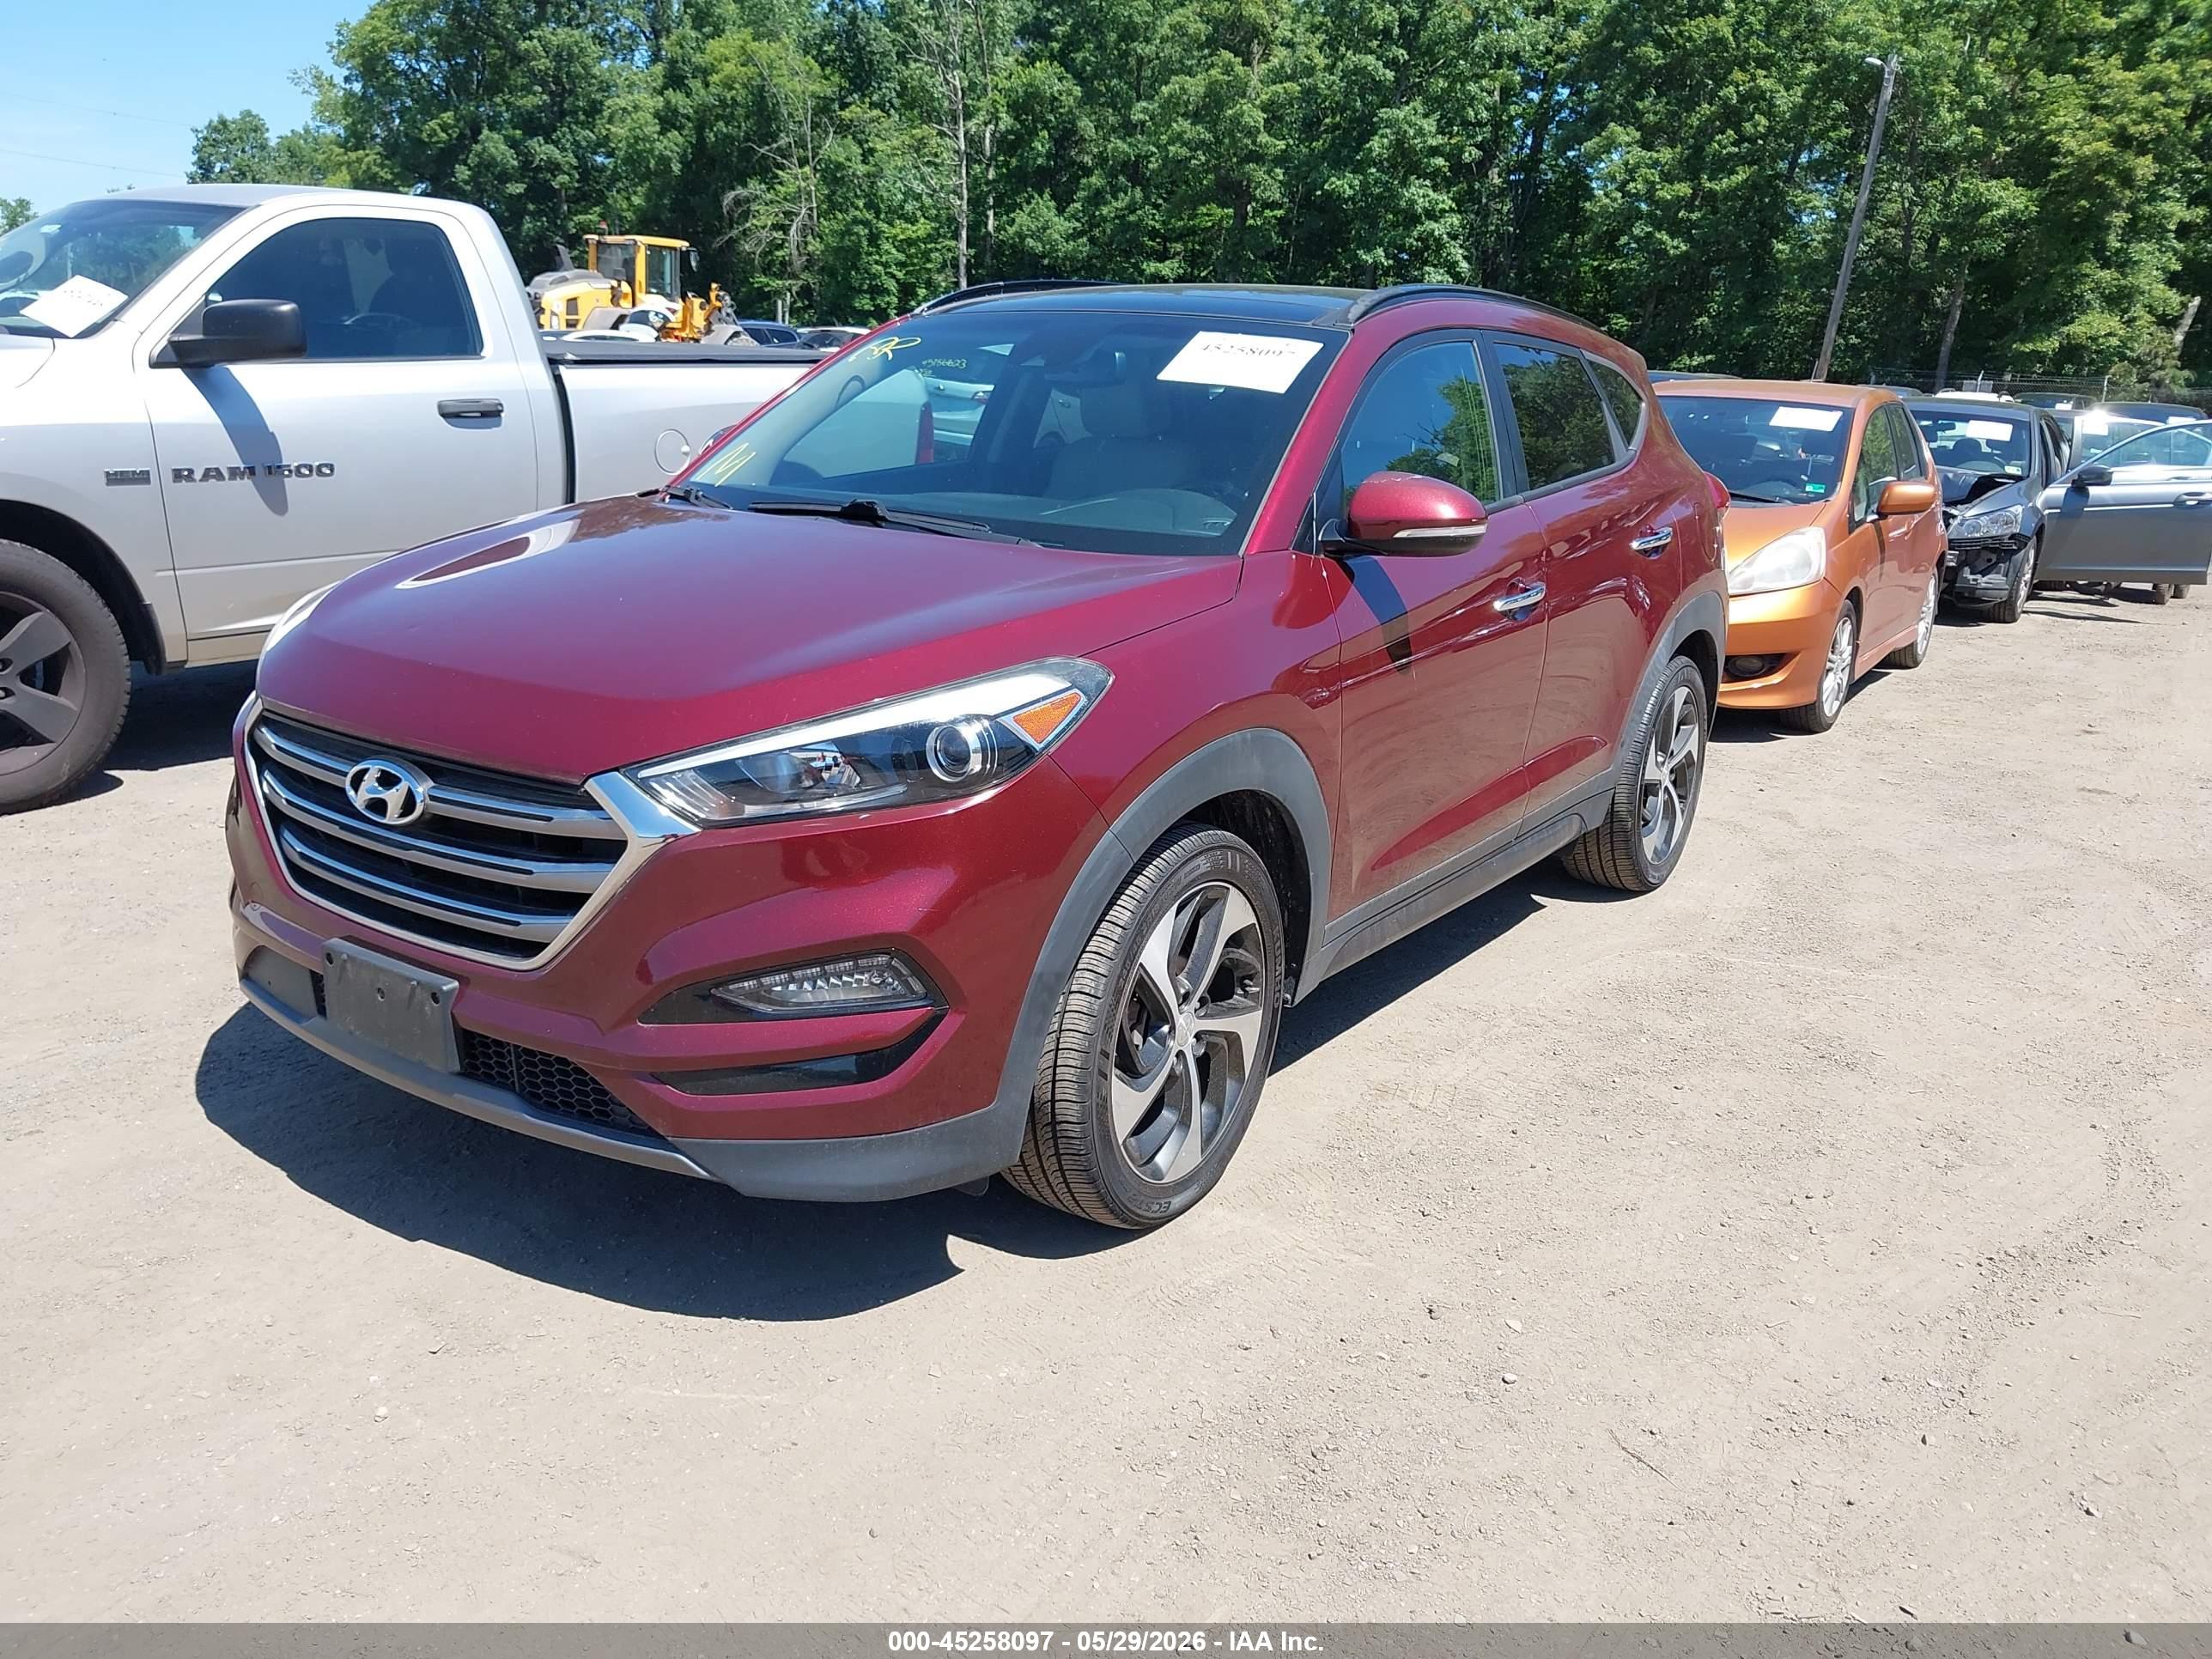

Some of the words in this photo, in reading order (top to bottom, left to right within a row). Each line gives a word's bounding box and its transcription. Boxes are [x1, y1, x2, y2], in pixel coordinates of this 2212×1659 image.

[172, 465, 256, 483] RAM
[264, 461, 335, 478] 1500
[1272, 925, 1283, 1010] KUMHO
